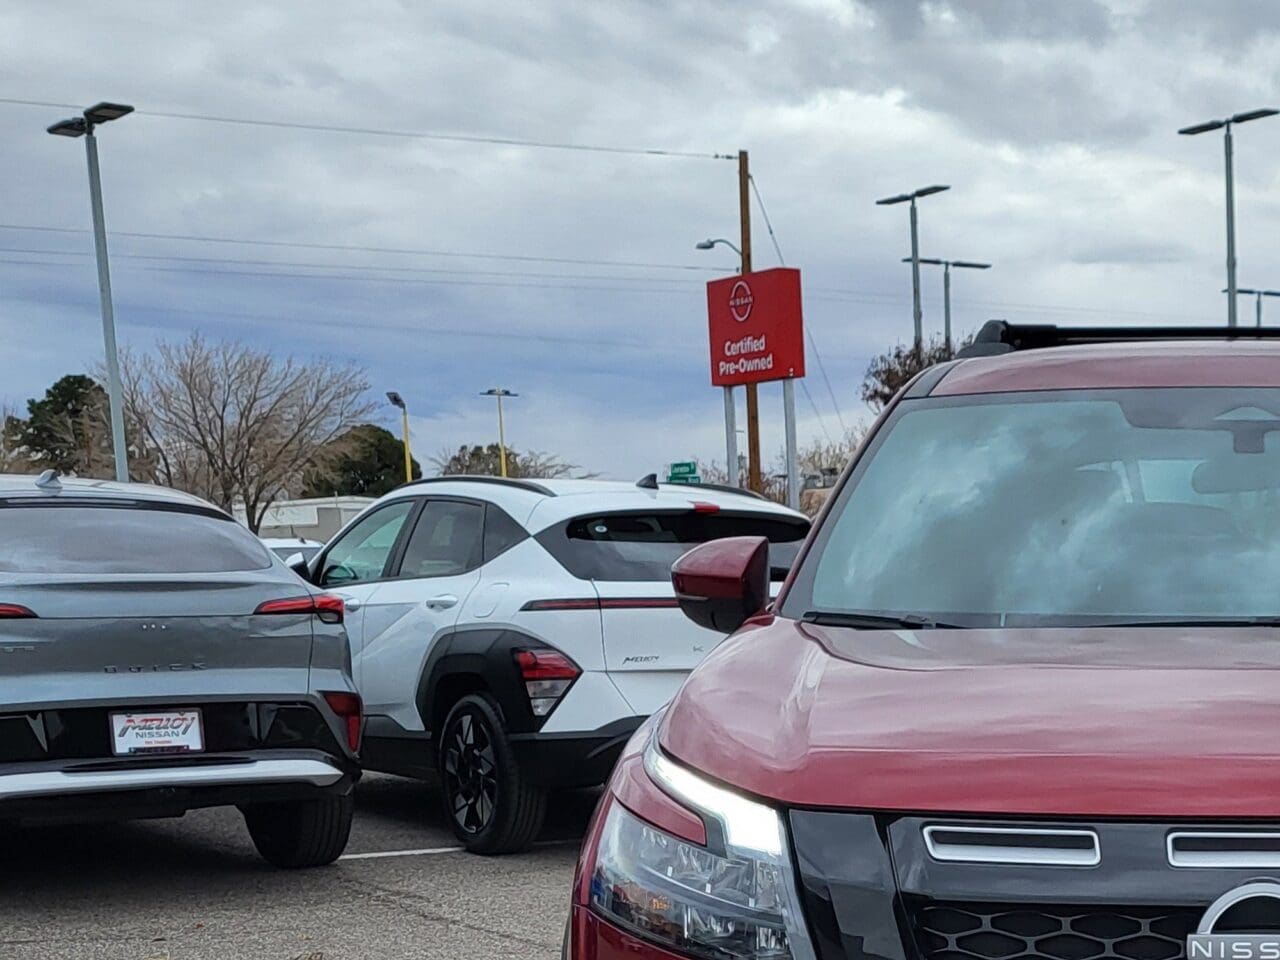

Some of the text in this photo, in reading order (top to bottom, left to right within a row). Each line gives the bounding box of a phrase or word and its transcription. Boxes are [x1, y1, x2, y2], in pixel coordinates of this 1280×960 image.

[724, 334, 766, 357] Certified
[719, 353, 773, 376] Pre-Owned
[135, 730, 180, 739] NISSAN
